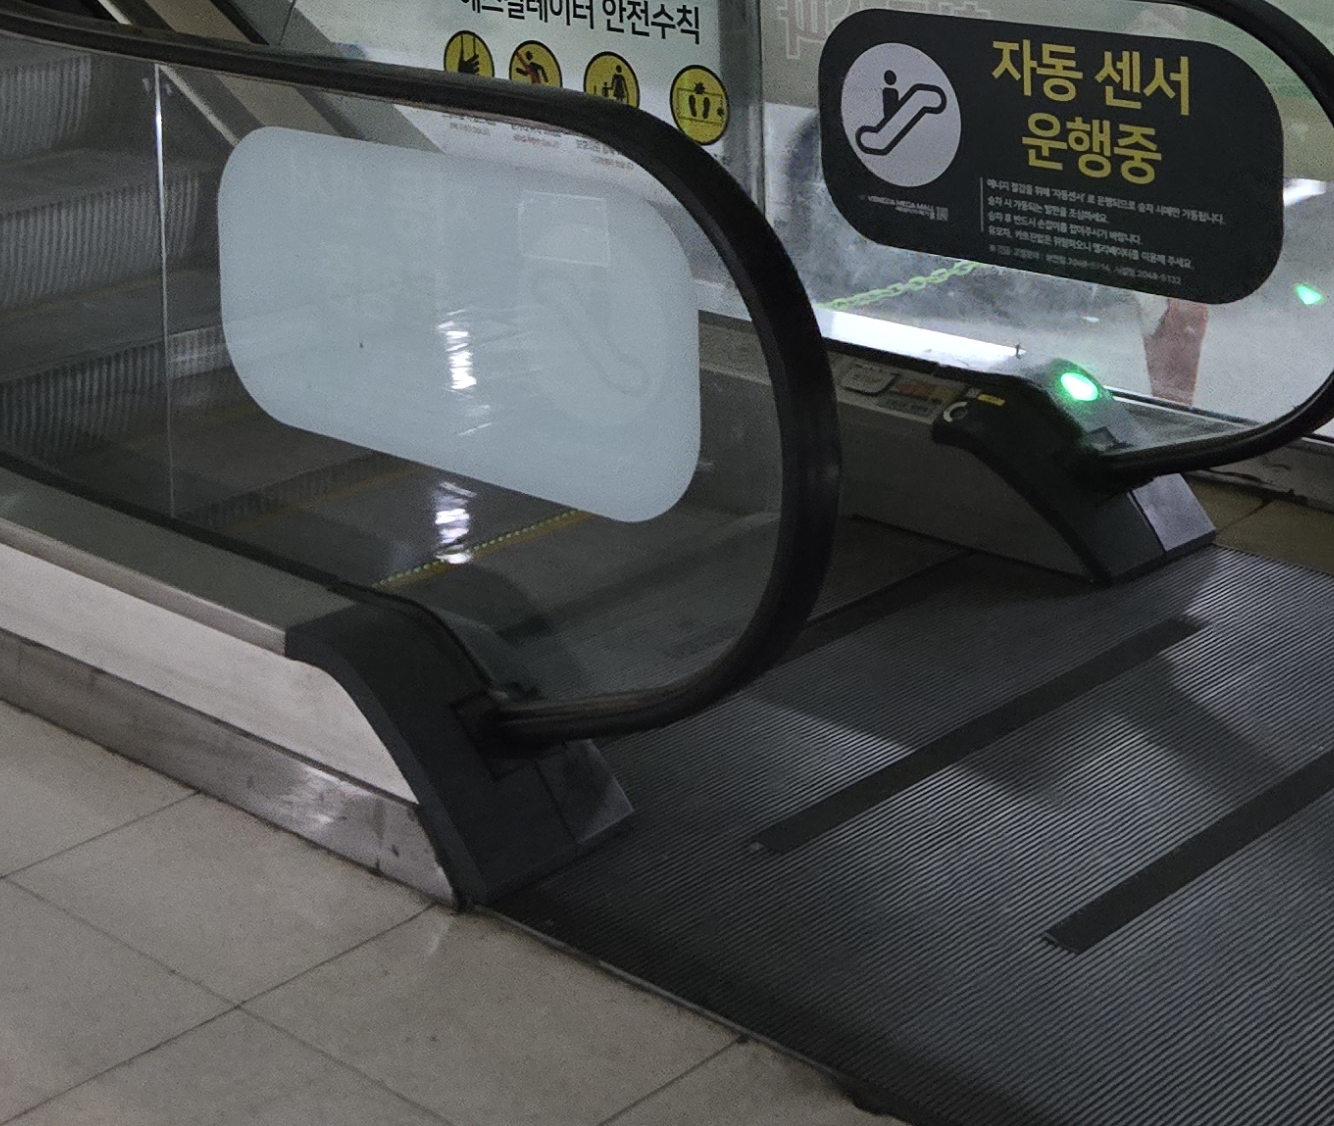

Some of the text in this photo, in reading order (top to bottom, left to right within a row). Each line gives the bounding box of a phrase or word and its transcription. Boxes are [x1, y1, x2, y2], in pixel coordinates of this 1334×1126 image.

[990, 38, 1191, 116] 자동 센서
[1020, 111, 1163, 185] 운행중
